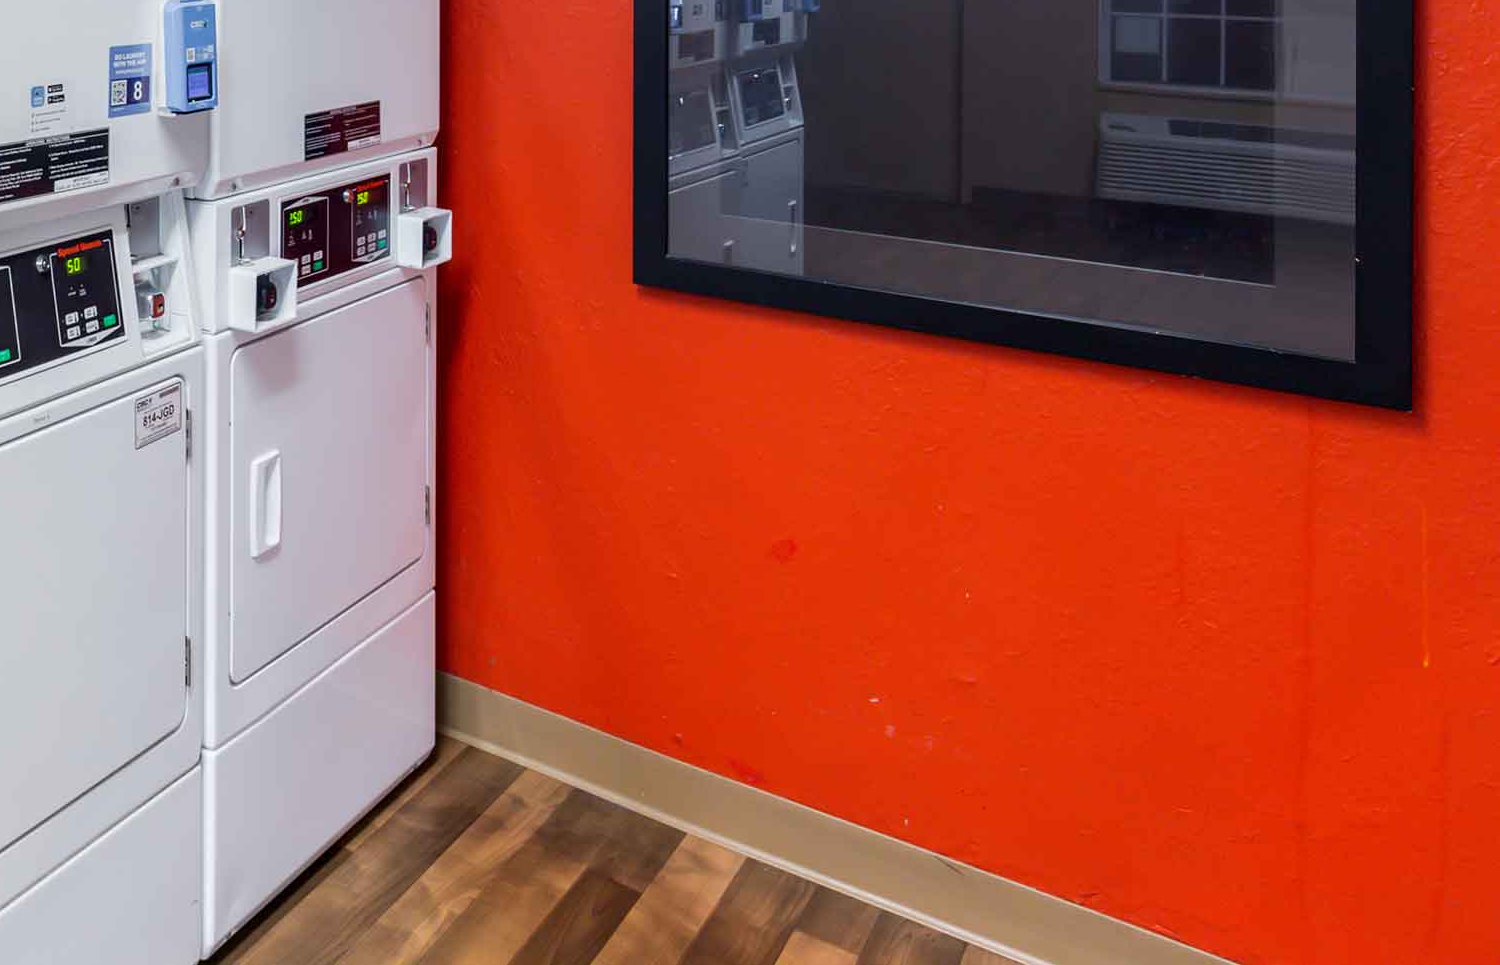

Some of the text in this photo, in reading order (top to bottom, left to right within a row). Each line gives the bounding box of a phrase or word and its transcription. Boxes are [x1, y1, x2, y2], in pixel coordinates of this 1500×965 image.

[134, 81, 143, 101] 8
[67, 257, 81, 274] 50
[143, 404, 175, 427] 814-JGD
